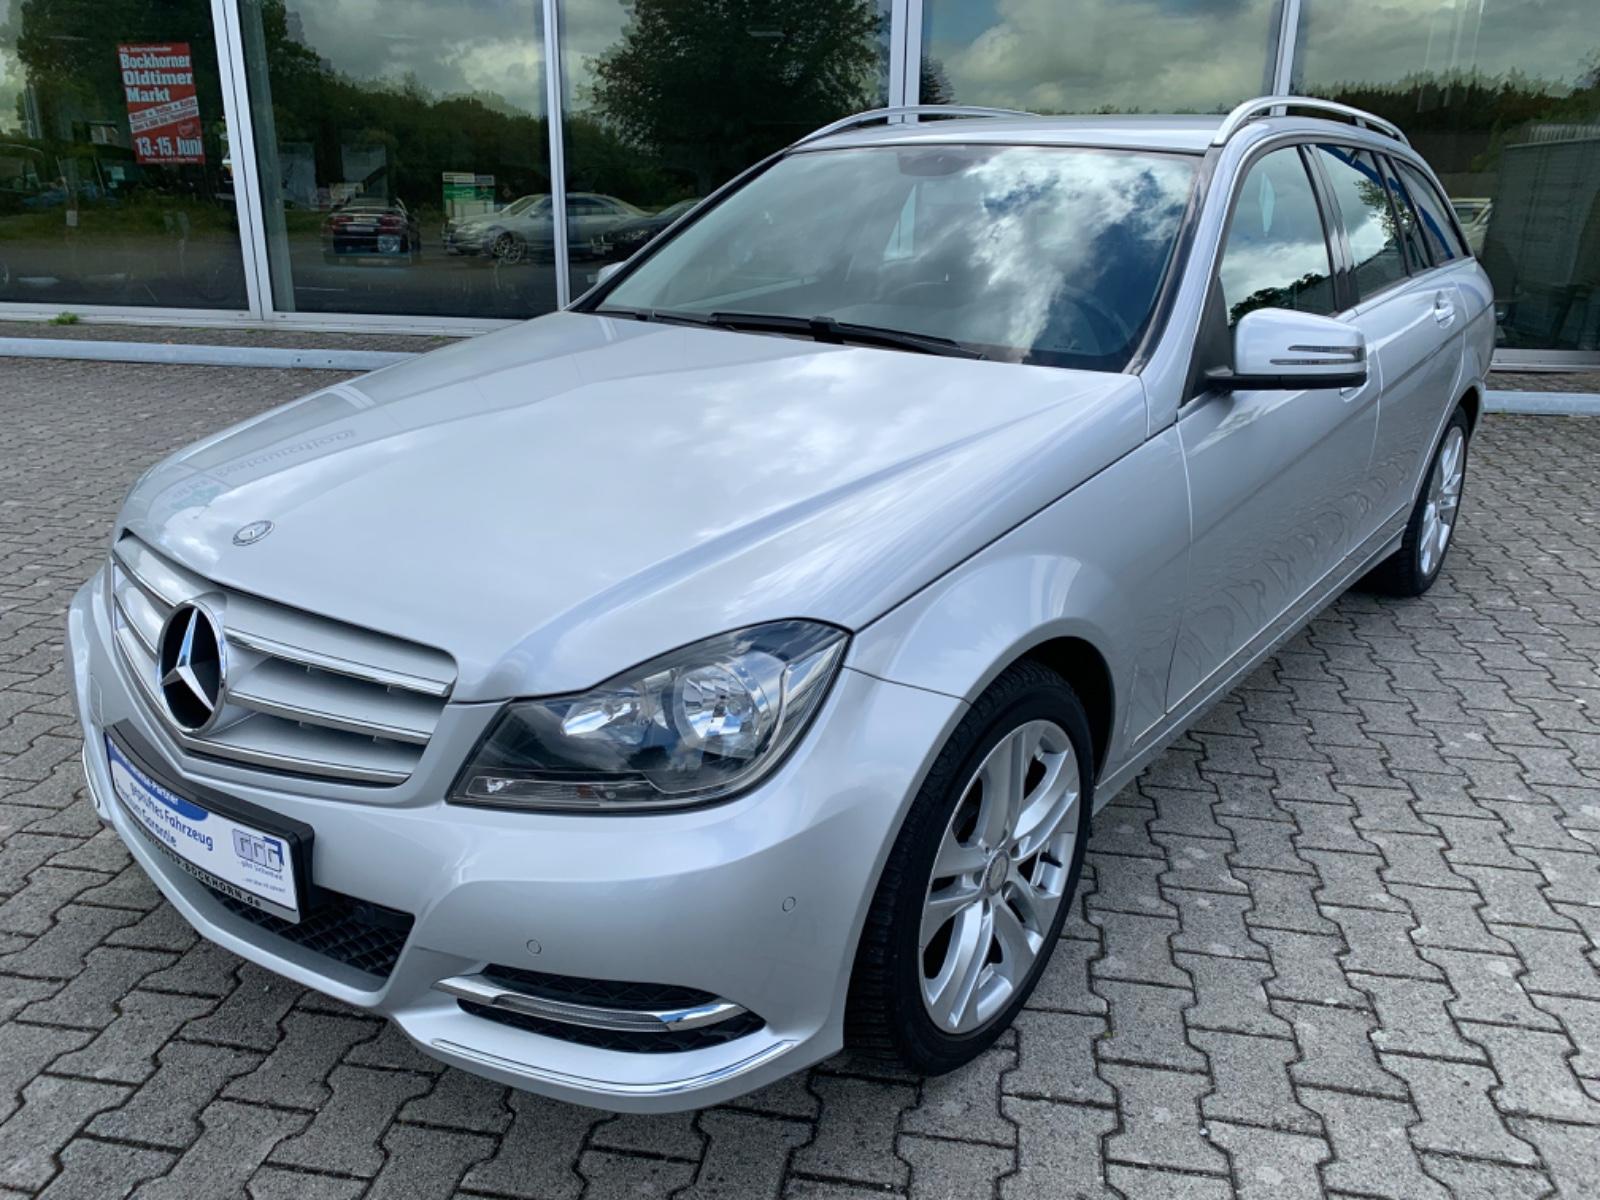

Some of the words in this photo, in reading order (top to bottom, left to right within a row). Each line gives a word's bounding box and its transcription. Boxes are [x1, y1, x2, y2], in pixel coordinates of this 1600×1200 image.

[119, 52, 191, 69] Bockhorner
[122, 69, 193, 86] Oldtimer
[125, 86, 170, 102] Markt
[135, 136, 175, 156] 13.-15.
[176, 136, 203, 156] Juni
[164, 808, 214, 852] Fahrzeug
